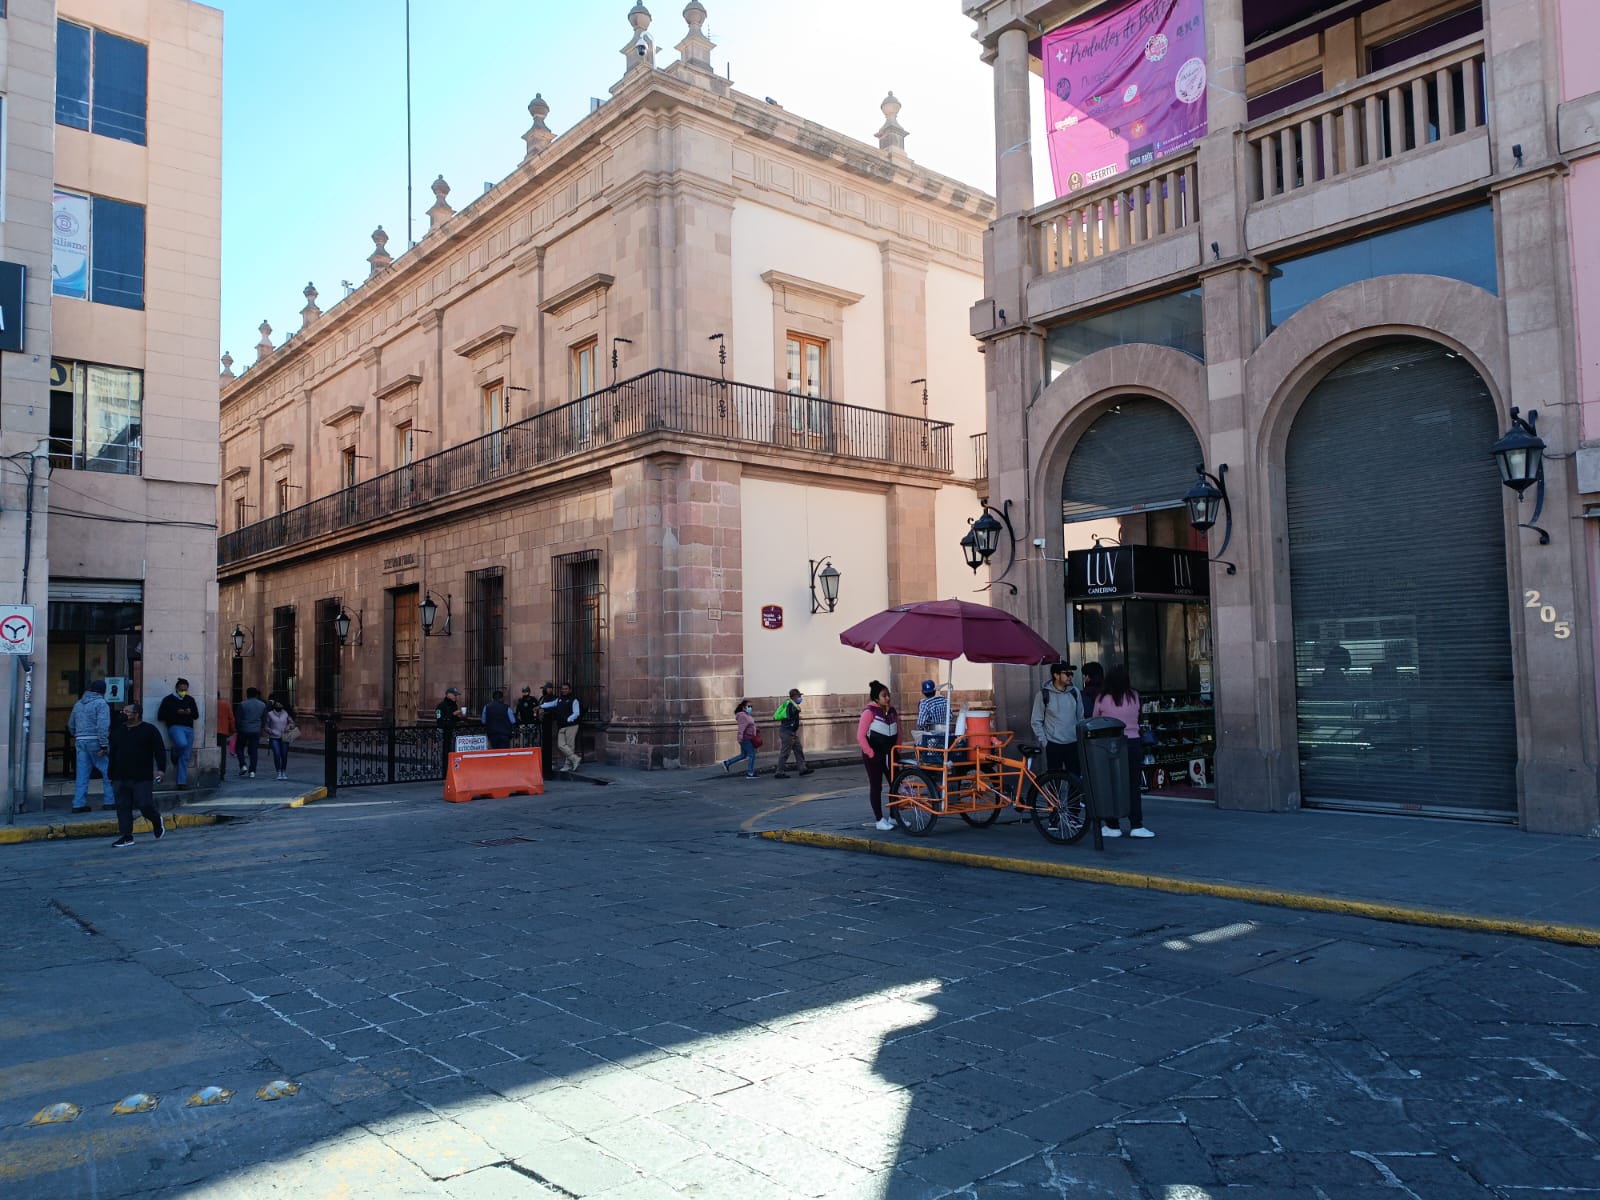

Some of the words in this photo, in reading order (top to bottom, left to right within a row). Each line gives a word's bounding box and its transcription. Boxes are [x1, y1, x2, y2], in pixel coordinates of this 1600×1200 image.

[1069, 26, 1120, 64] Productos
[1087, 552, 1118, 586] LUV
[1525, 590, 1571, 639] 205
